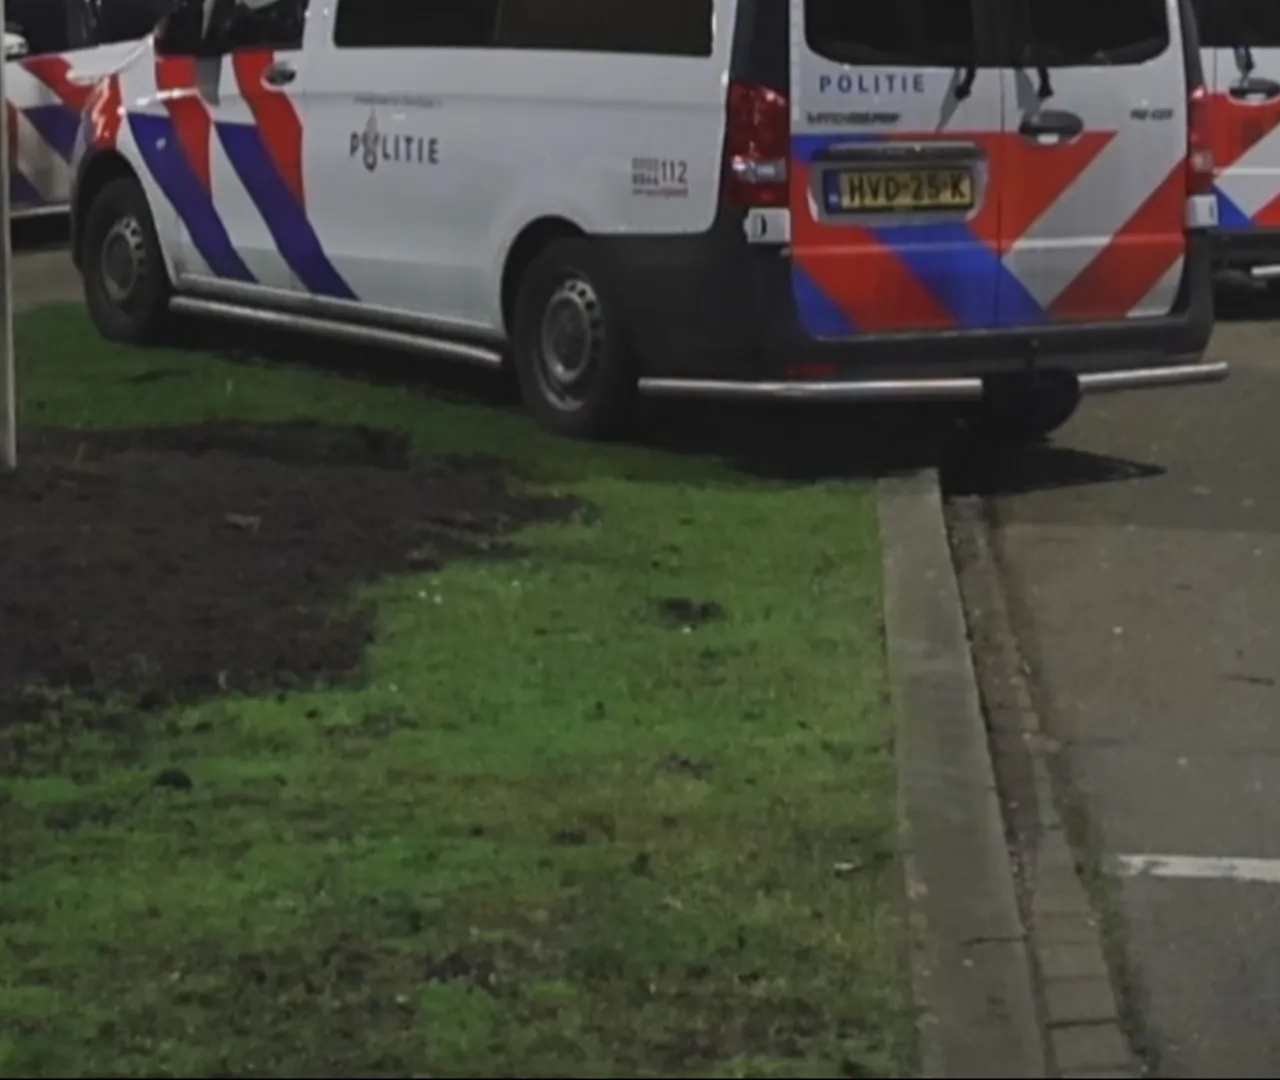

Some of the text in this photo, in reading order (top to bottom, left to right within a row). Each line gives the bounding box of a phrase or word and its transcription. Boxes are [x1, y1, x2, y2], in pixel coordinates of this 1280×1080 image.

[819, 73, 926, 94] POLITIE
[349, 129, 440, 173] POLITIE
[661, 159, 688, 185] 112
